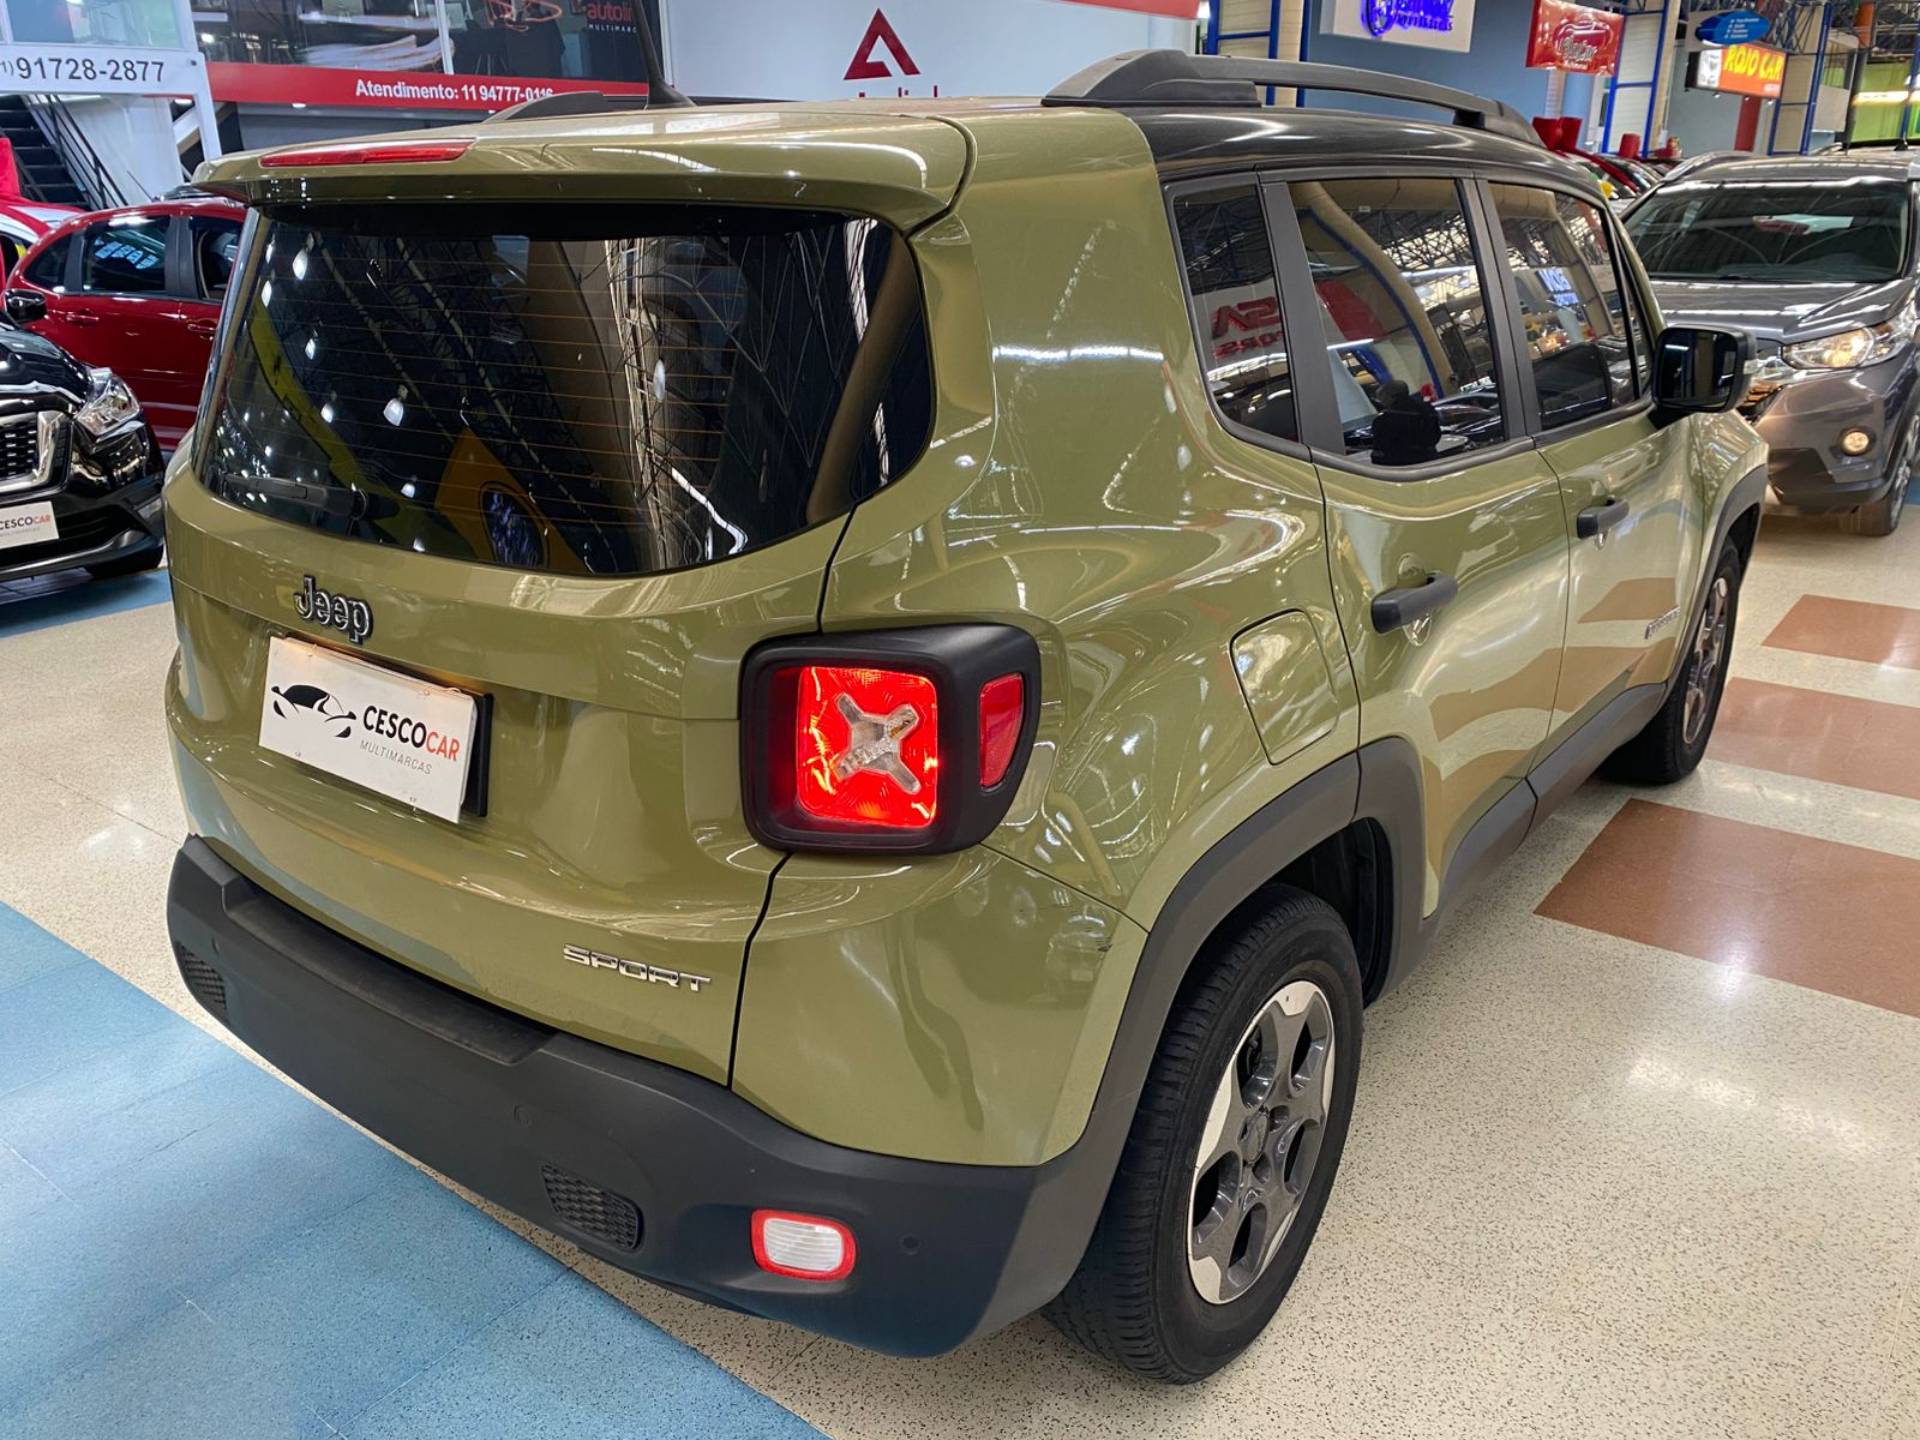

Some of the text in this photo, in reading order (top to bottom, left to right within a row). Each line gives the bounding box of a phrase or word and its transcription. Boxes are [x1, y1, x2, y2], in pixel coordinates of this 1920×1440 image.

[16, 57, 165, 83] 91728-2877
[1724, 44, 1760, 76] ROJO
[1759, 52, 1785, 81] CAR
[355, 79, 459, 99] Atendimento:
[461, 85, 476, 101] 11
[293, 574, 374, 645] Jeep
[363, 705, 460, 762] CESCOCAR
[360, 739, 433, 775] MULTIMARCAS
[563, 943, 712, 992] SPORT
